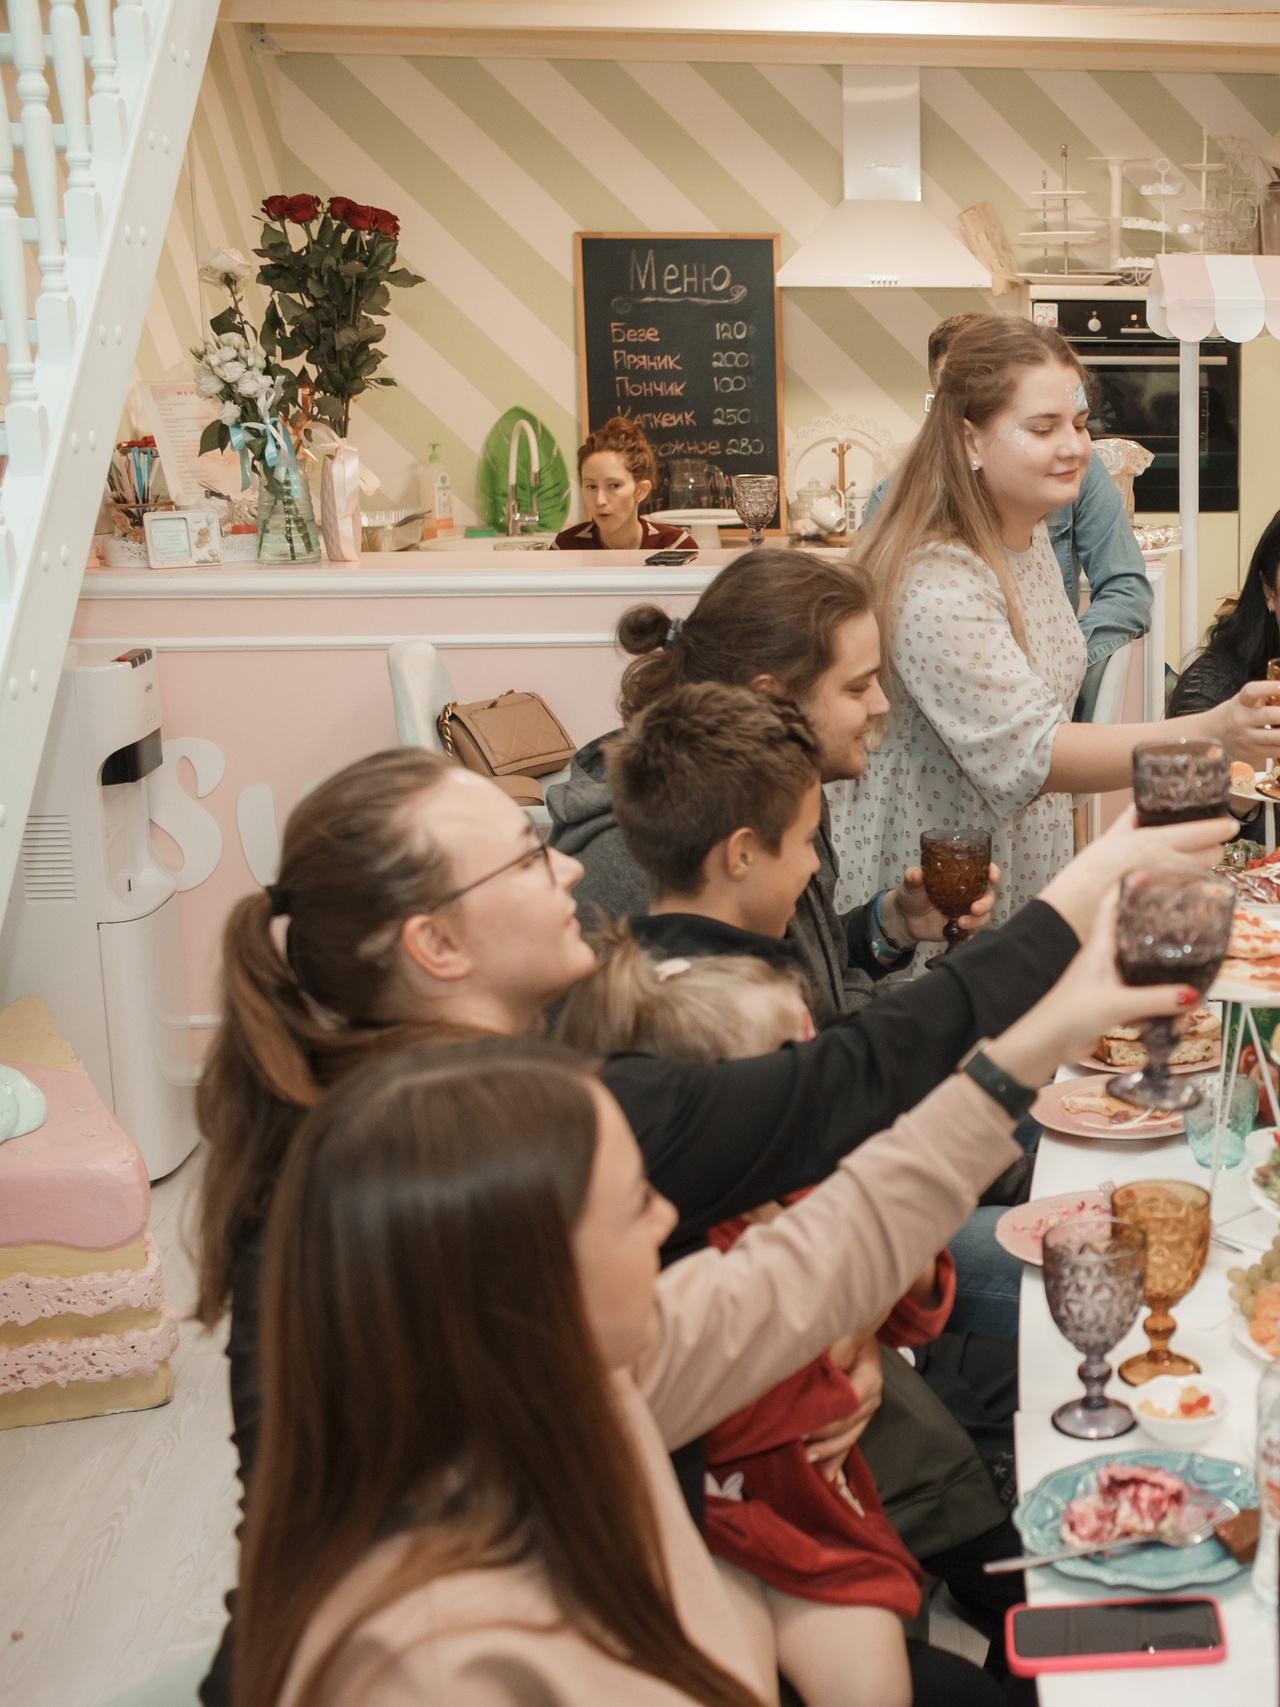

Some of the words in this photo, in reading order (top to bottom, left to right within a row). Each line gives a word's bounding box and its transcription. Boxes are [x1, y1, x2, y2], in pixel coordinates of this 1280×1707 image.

[629, 248, 732, 294] Меню
[610, 321, 661, 343] Безе
[612, 349, 684, 371] Пряник
[615, 375, 687, 397] Пончик
[725, 437, 765, 456] 280
